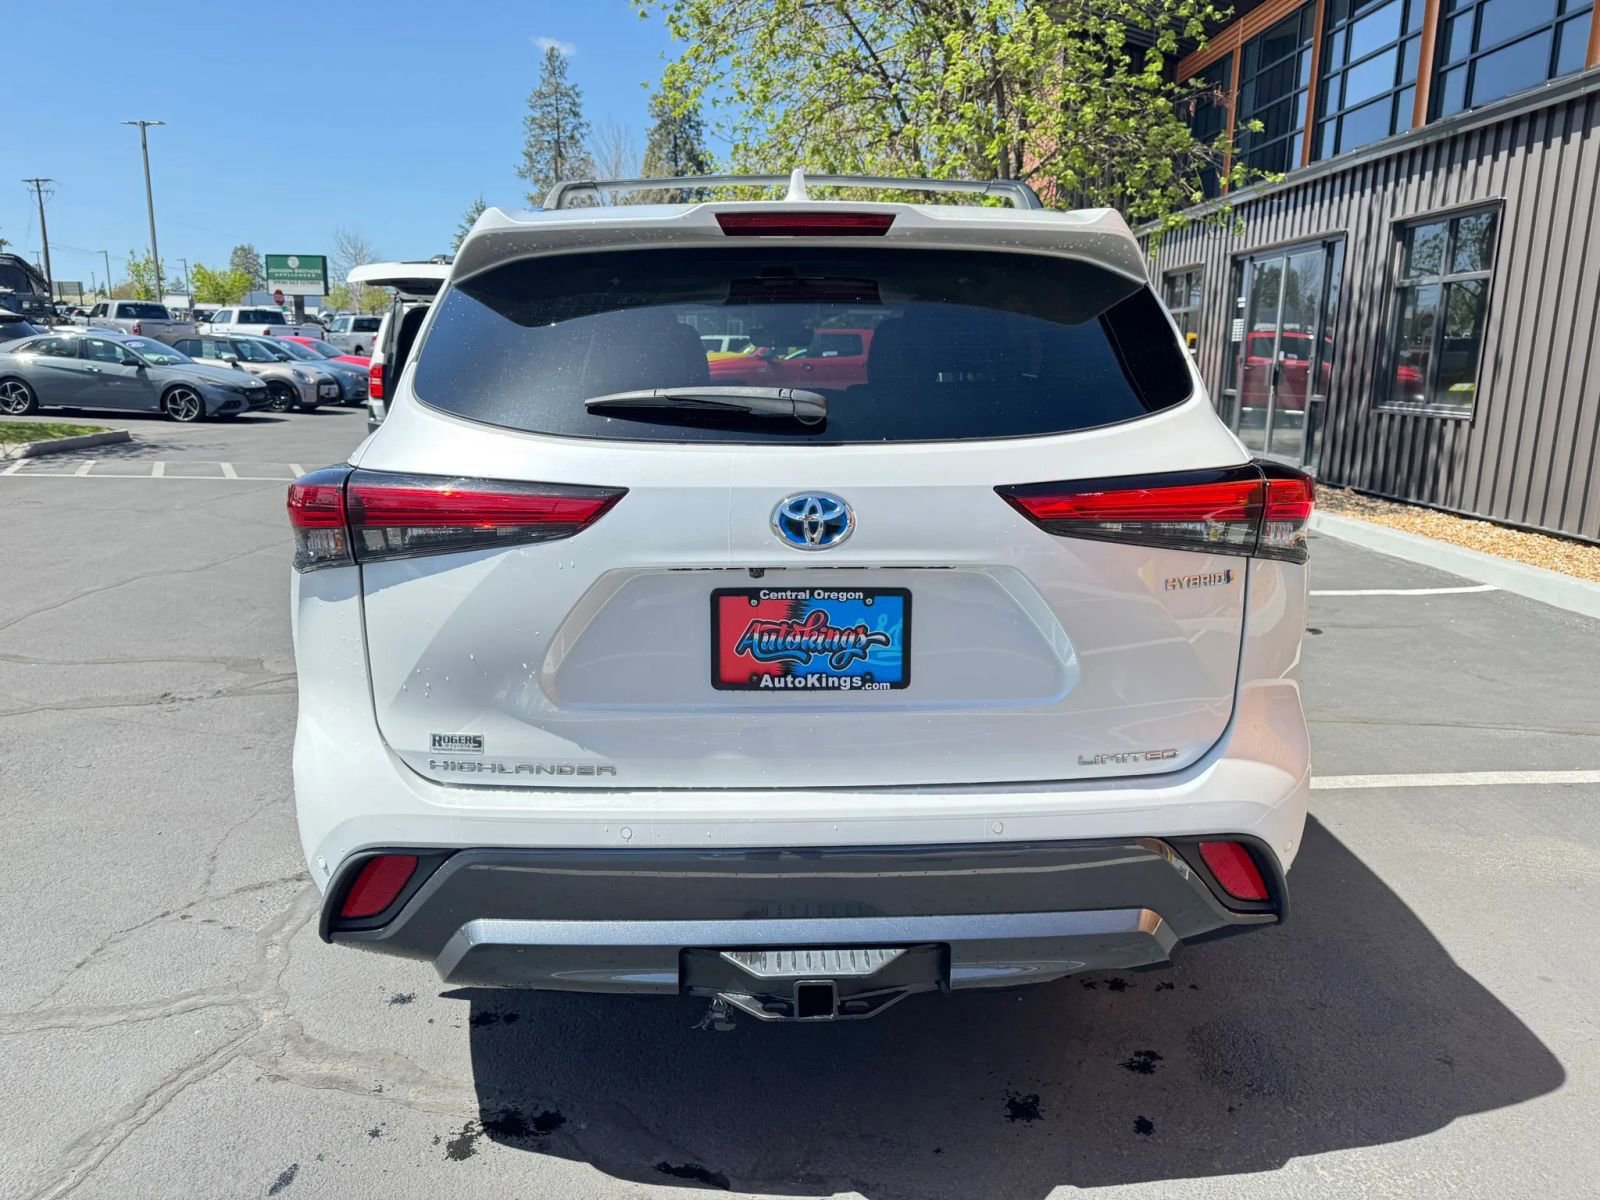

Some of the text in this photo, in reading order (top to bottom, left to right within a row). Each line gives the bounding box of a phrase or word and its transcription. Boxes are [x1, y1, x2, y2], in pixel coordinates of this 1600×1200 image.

[1165, 570, 1231, 591] HYBRID
[759, 589, 864, 602] Central Oregon
[759, 673, 891, 690] AutoKings.com
[432, 733, 482, 748] ROGERS
[1078, 748, 1179, 766] LIMITED
[429, 759, 617, 777] HIGHLANDER
